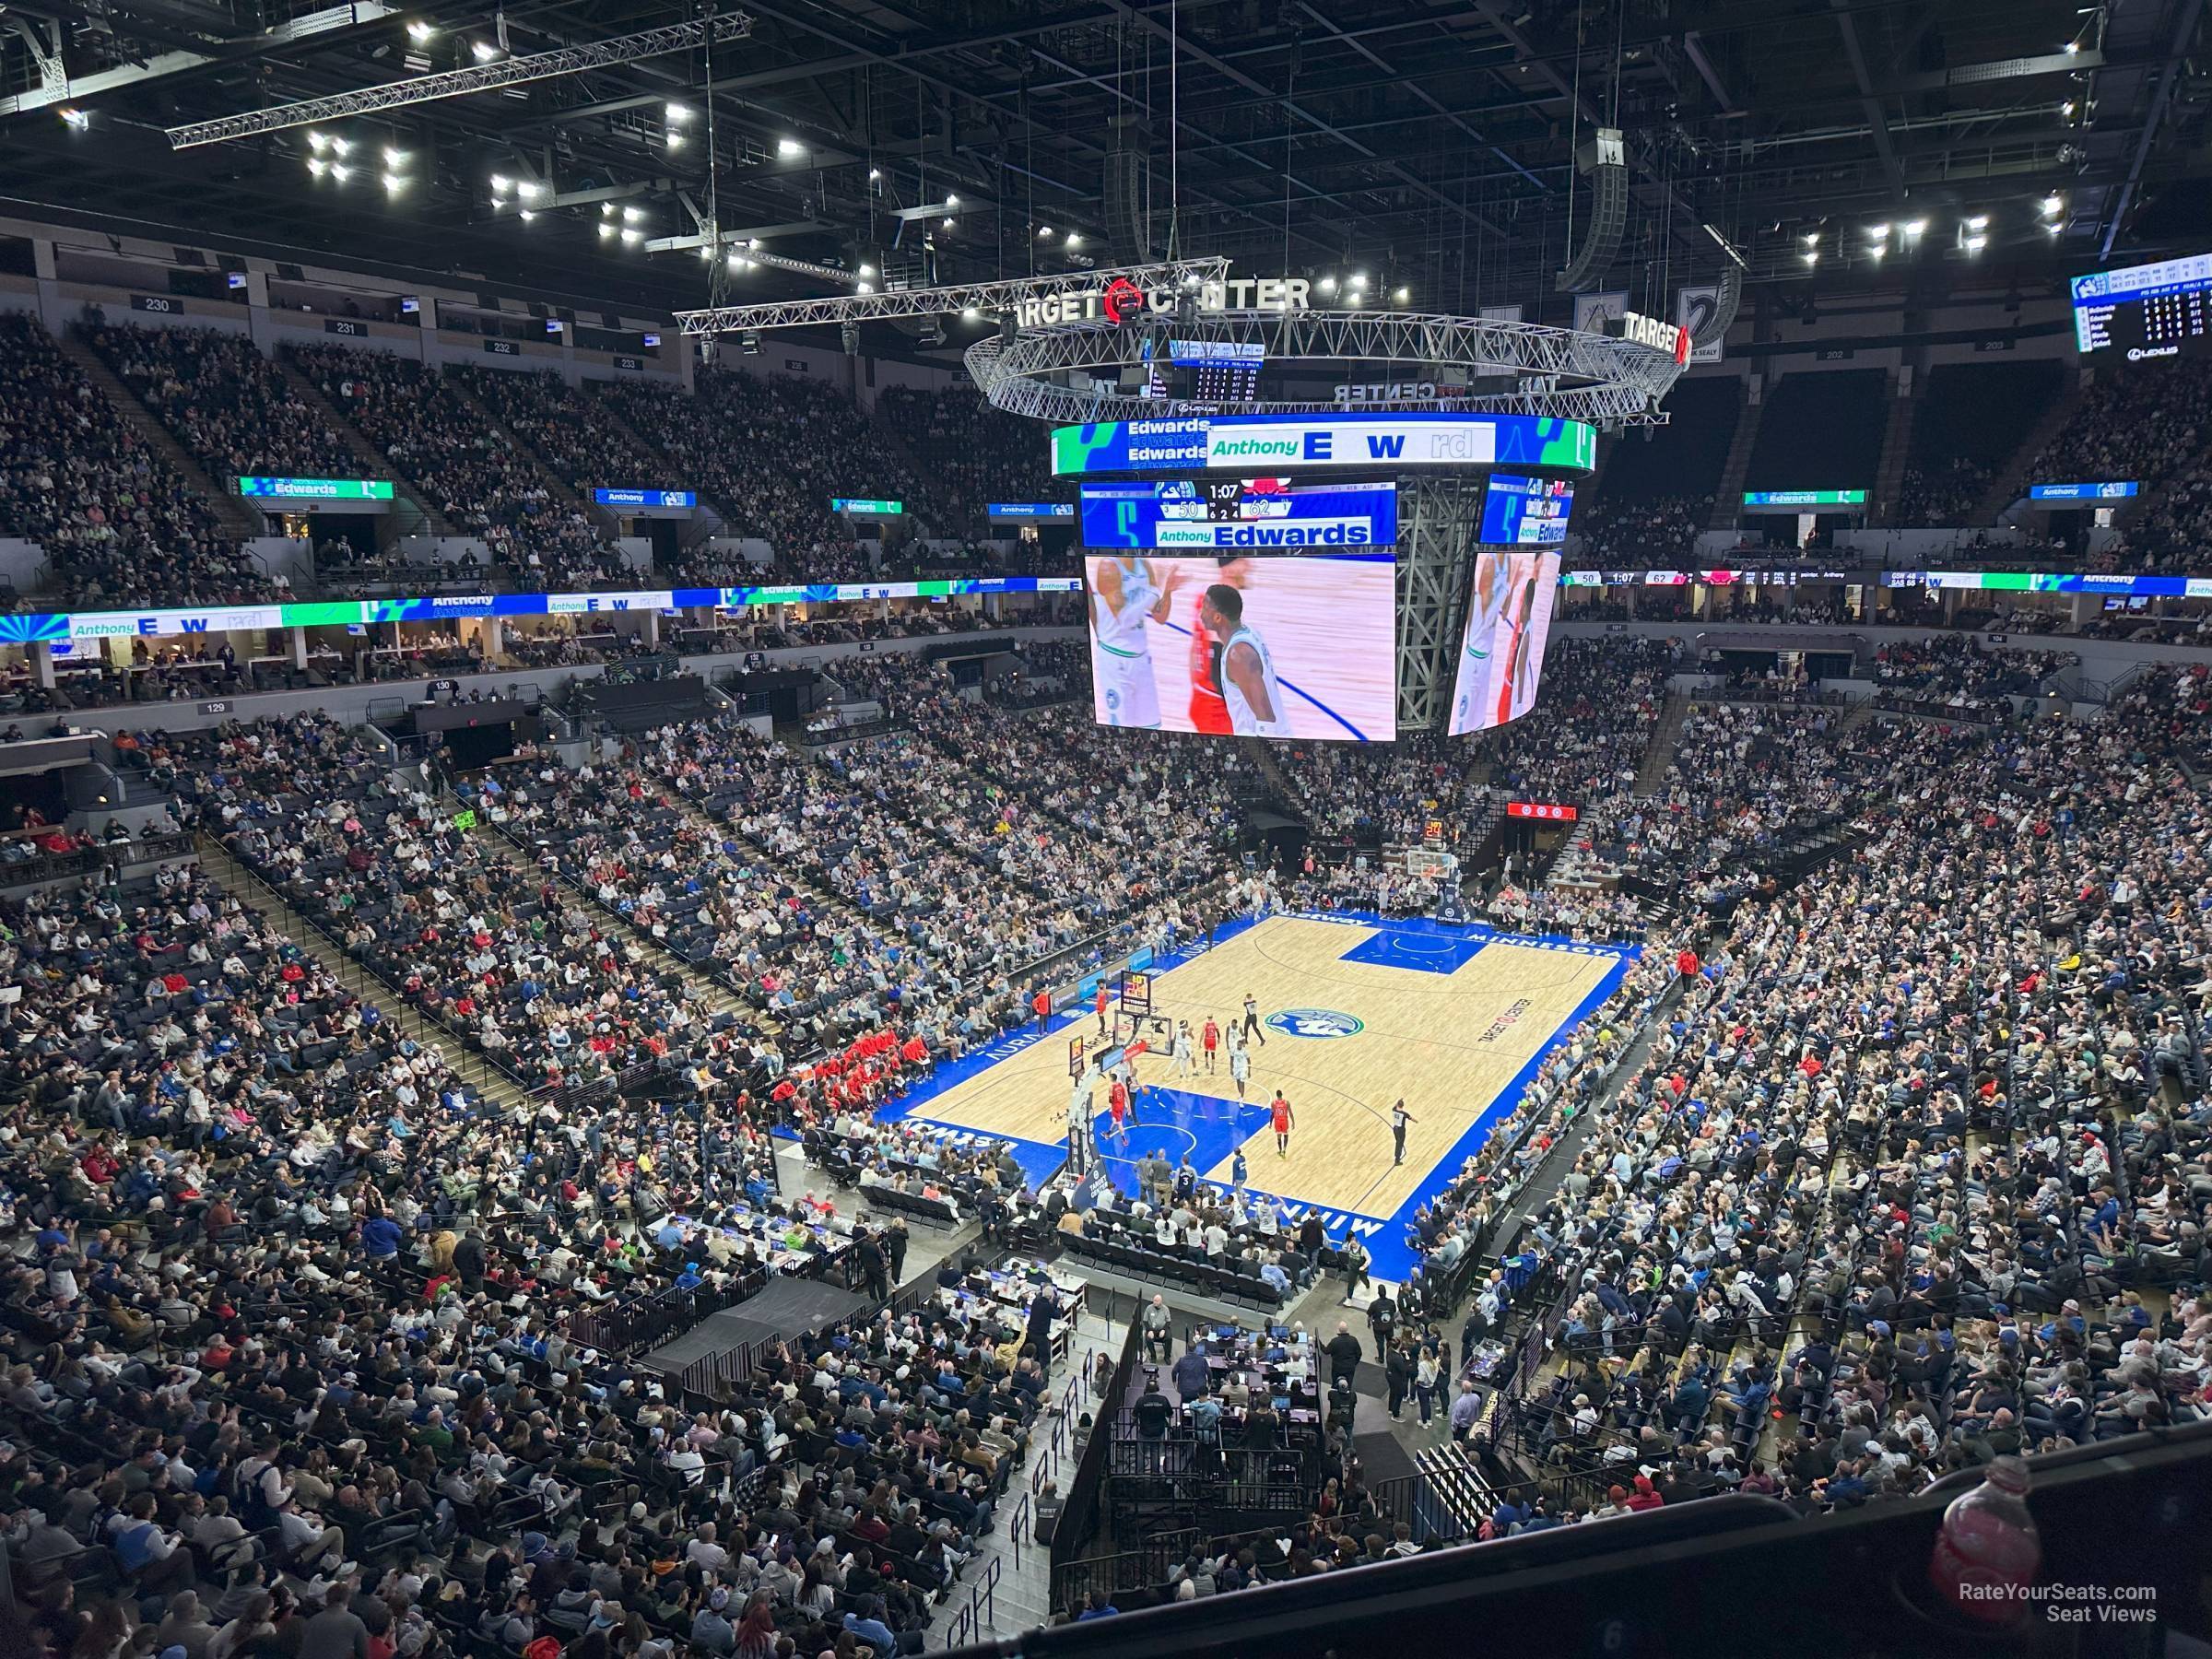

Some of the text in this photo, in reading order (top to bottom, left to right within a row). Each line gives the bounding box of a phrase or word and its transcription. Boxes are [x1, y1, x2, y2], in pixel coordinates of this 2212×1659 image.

[146, 299, 170, 312] 230
[999, 288, 1098, 327] ARGET
[336, 323, 355, 335] 231
[1624, 312, 1680, 354] TARGET
[494, 342, 511, 353] 232
[1985, 342, 2004, 350] 203
[1699, 347, 1717, 357] SEALY
[1826, 351, 1843, 359] 202
[2140, 347, 2179, 358] LEXUS
[622, 358, 635, 368] 233
[1128, 419, 1210, 435] Edwards
[1128, 433, 1207, 448] Edwards
[1212, 439, 1298, 456] Anthony
[1303, 431, 1332, 459] E
[1431, 429, 1473, 458] rd
[1128, 446, 1207, 461] Edwards
[276, 484, 337, 494] Edwards
[1210, 485, 1238, 500] 1:07
[2042, 488, 2079, 497] Anthony
[608, 493, 643, 502] Anthony
[1179, 501, 1198, 517] 50
[1249, 500, 1270, 516] 62
[1209, 510, 1239, 520] 6 2 4
[1159, 524, 1368, 545] Anthony Edwards
[1613, 573, 1635, 582] 1:07
[1070, 582, 1079, 590] E
[839, 591, 862, 599] Anthony
[863, 589, 870, 598] E
[432, 595, 494, 606] Anthony
[550, 602, 586, 612] Anthony
[587, 599, 599, 610] E
[75, 624, 135, 636] Anthony
[138, 618, 158, 634] E
[436, 681, 450, 690] 130
[206, 702, 225, 713] 129
[1467, 934, 1622, 959] MINNESOTA
[1477, 998, 1534, 1043] TARGET CENTER
[1089, 1174, 1107, 1192] TARGET
[1183, 1177, 1189, 1185] 3
[1090, 1182, 1108, 1198] CENTER
